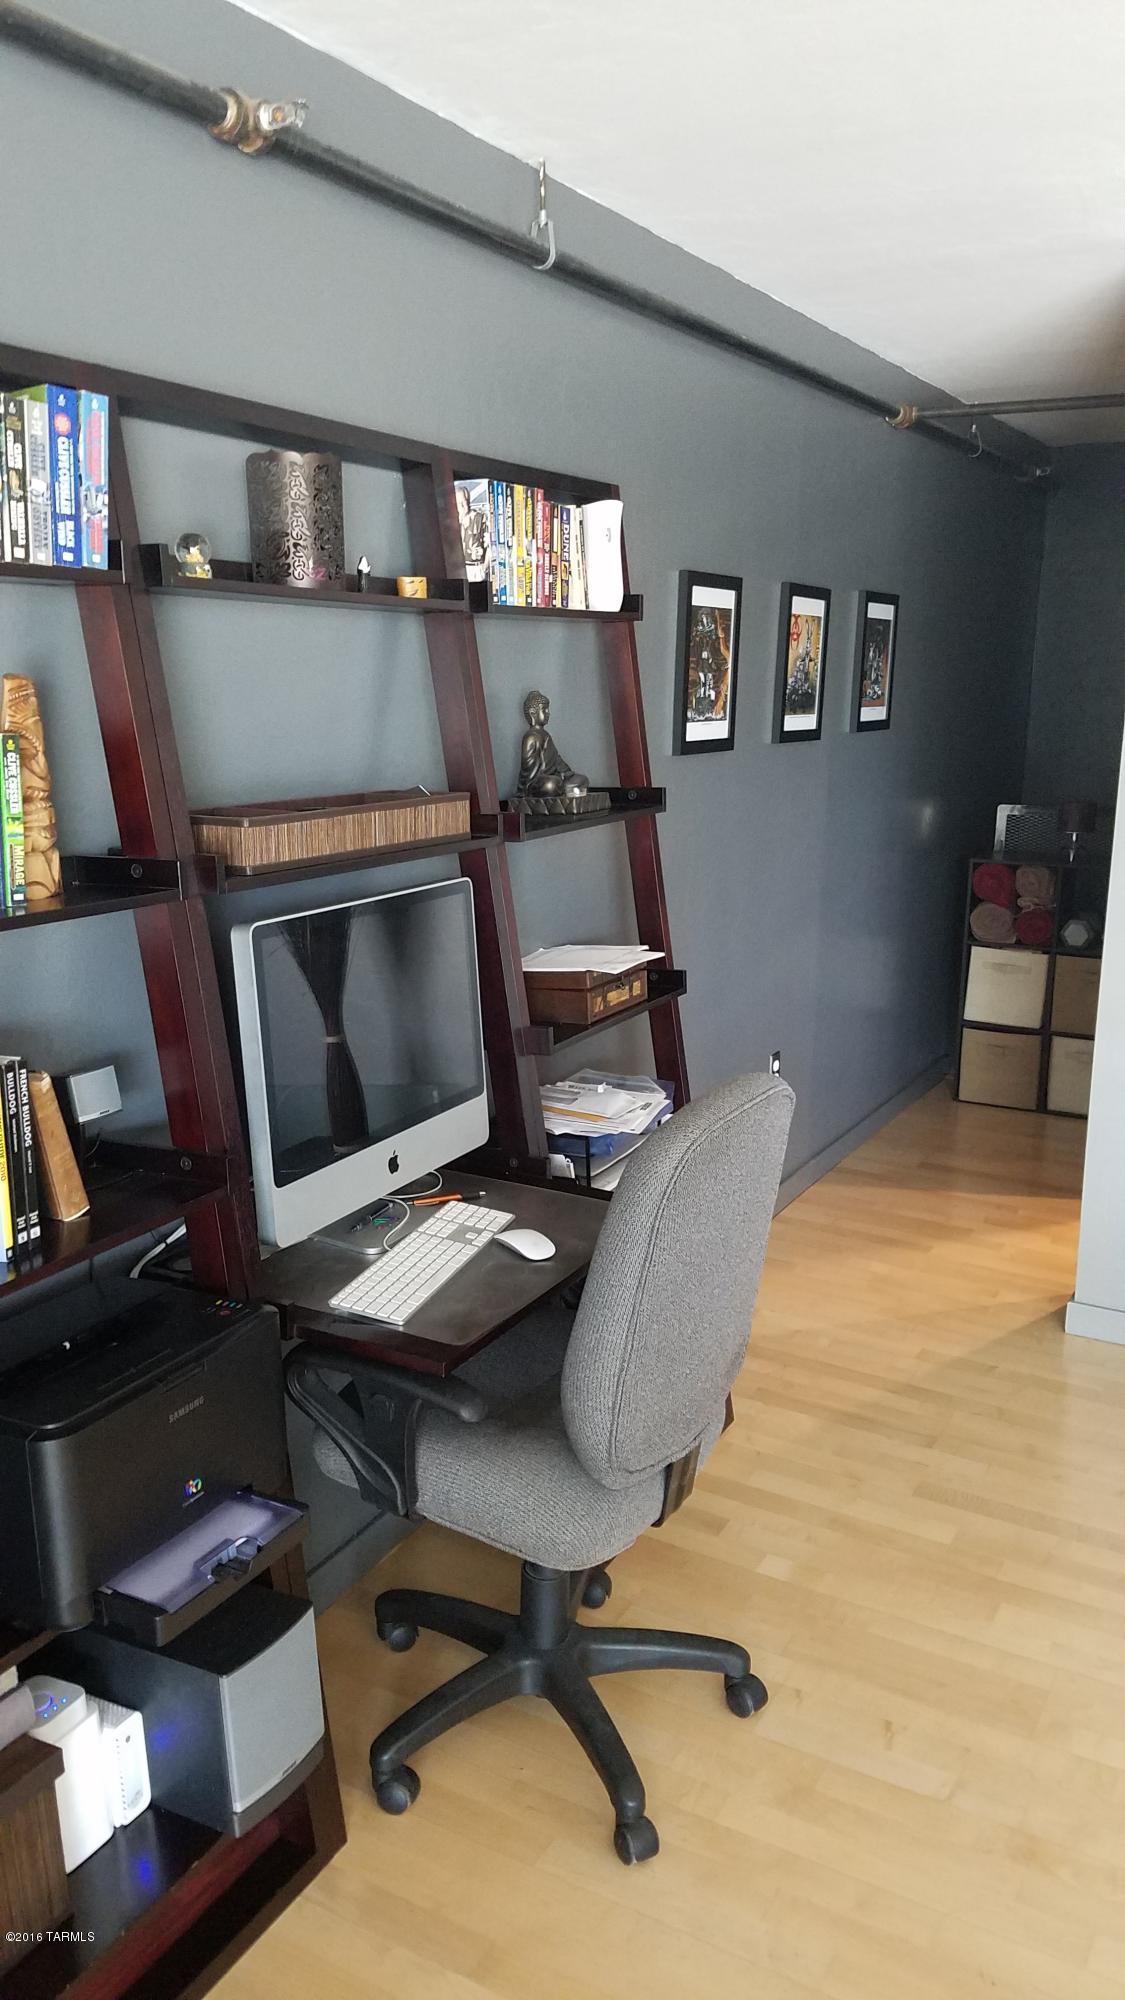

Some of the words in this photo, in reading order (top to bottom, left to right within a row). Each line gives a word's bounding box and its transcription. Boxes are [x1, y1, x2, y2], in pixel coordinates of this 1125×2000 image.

[7, 752, 17, 776] CLIVE
[14, 845, 25, 886] MIRAGE
[6, 1072, 16, 1115] BULLDOG
[19, 1068, 28, 1104] FRENCH
[22, 1105, 32, 1147] BULLDOG
[168, 1395, 205, 1424] SAMSUNG
